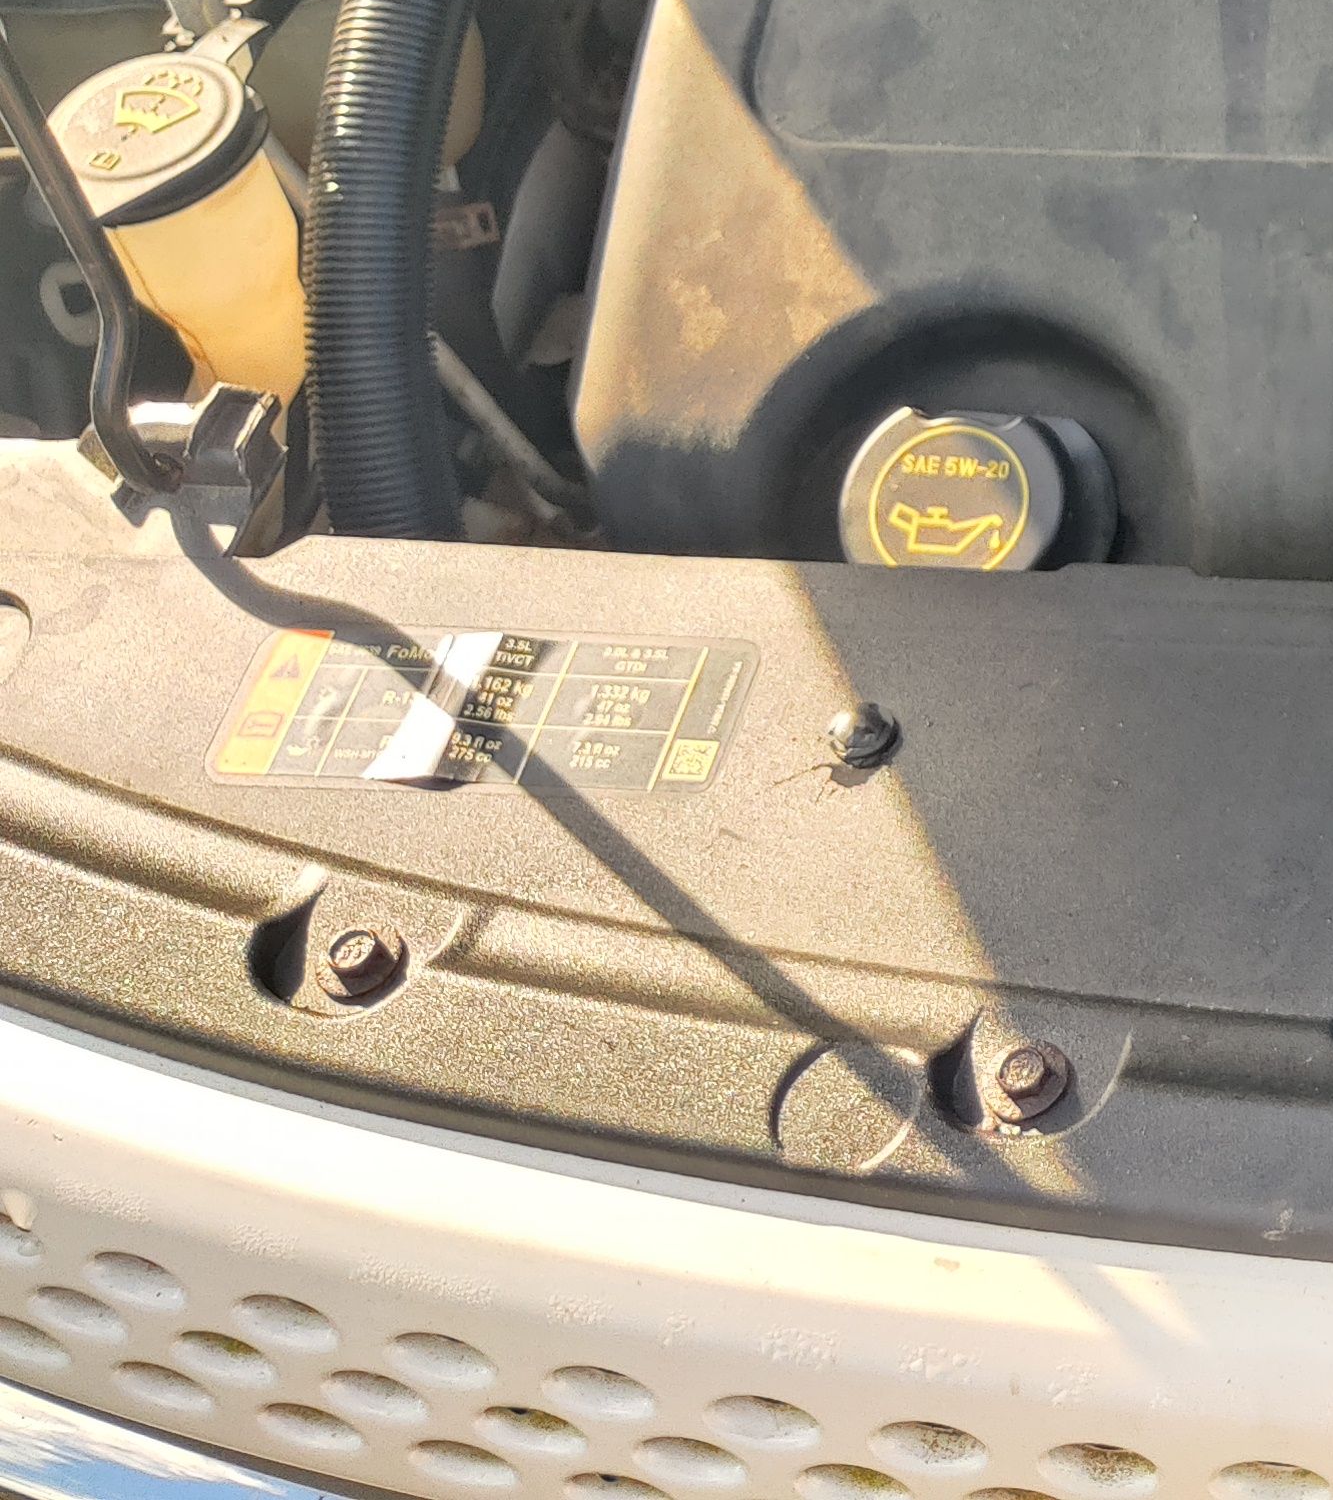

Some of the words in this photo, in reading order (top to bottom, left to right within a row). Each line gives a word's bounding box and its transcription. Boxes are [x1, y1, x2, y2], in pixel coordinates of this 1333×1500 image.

[900, 453, 941, 477] SAE
[943, 454, 1011, 480] 5W-20
[513, 680, 535, 699] kg
[590, 683, 630, 701] 1.332
[630, 686, 651, 704] kg
[463, 703, 493, 719] 2.56
[495, 696, 514, 708] oz
[449, 744, 476, 761] 275
[475, 751, 493, 763] cc
